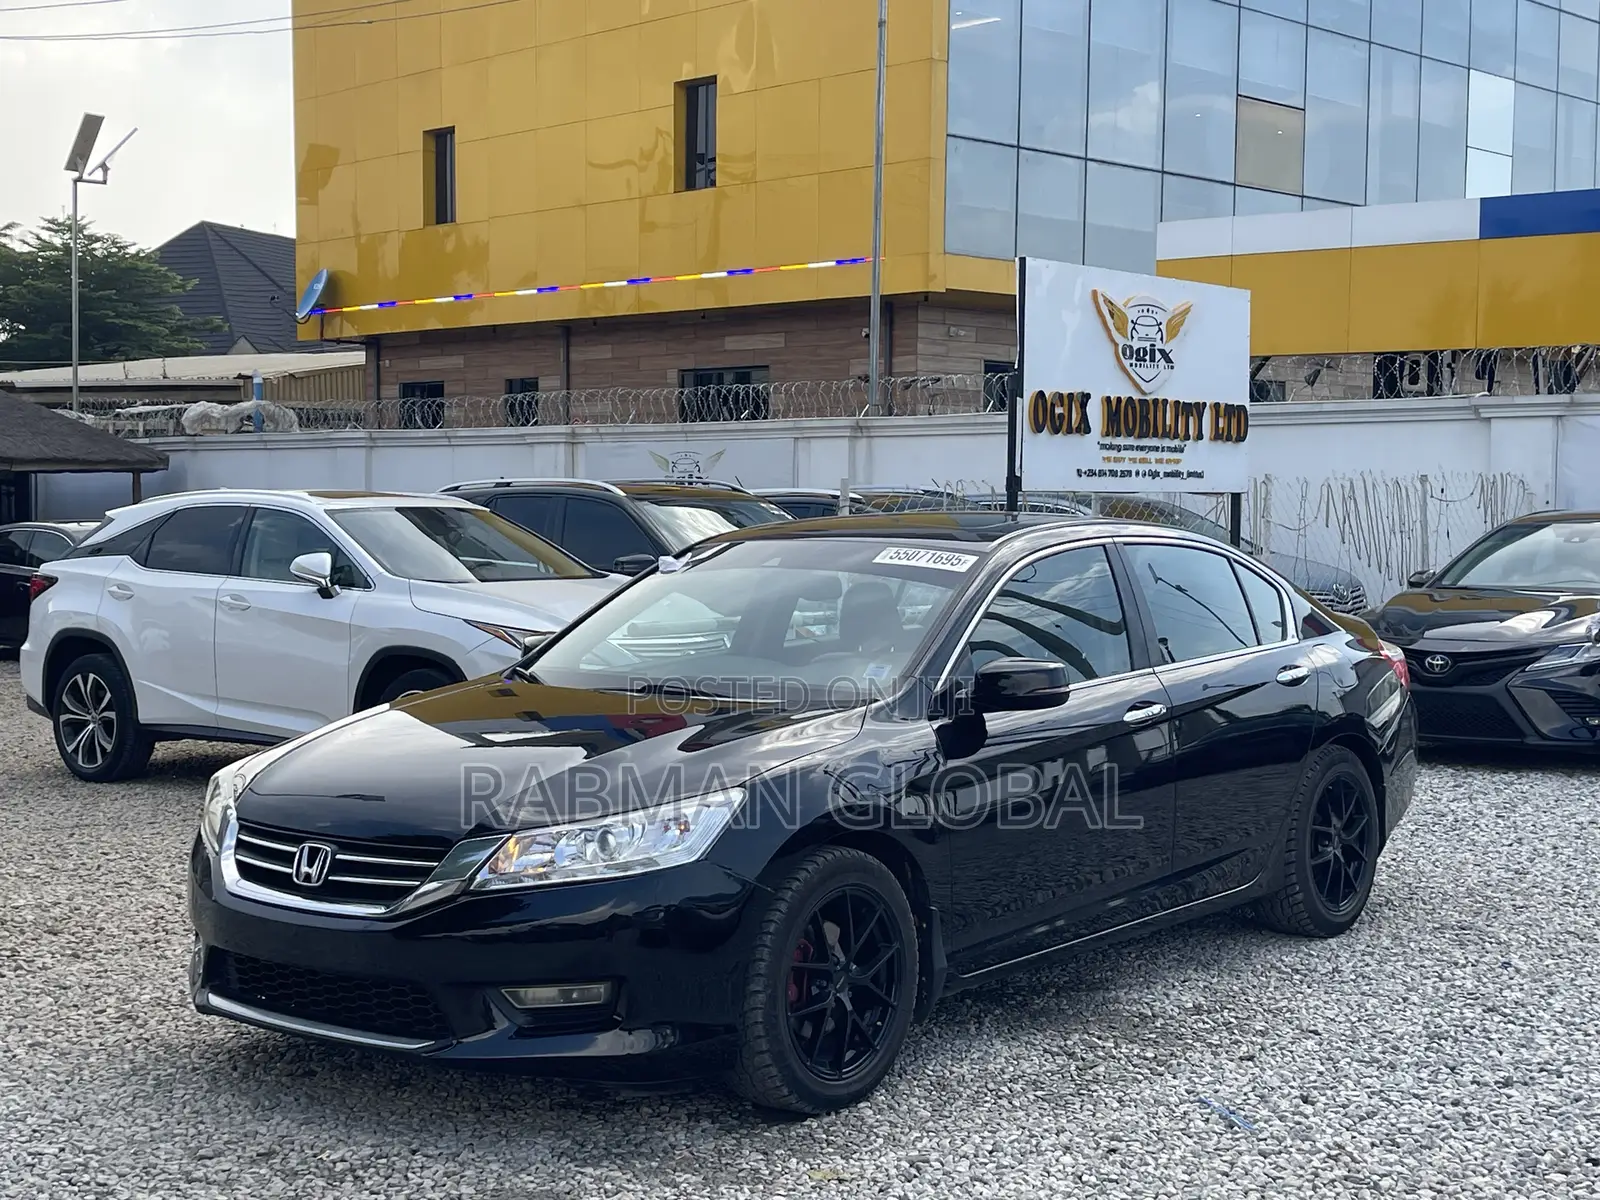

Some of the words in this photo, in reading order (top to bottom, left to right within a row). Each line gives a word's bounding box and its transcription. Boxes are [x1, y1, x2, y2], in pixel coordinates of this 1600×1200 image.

[1028, 389, 1092, 436] OGIX
[1100, 395, 1208, 442] MOBILITY
[1209, 401, 1249, 443] LTD
[1135, 444, 1160, 454] everyone
